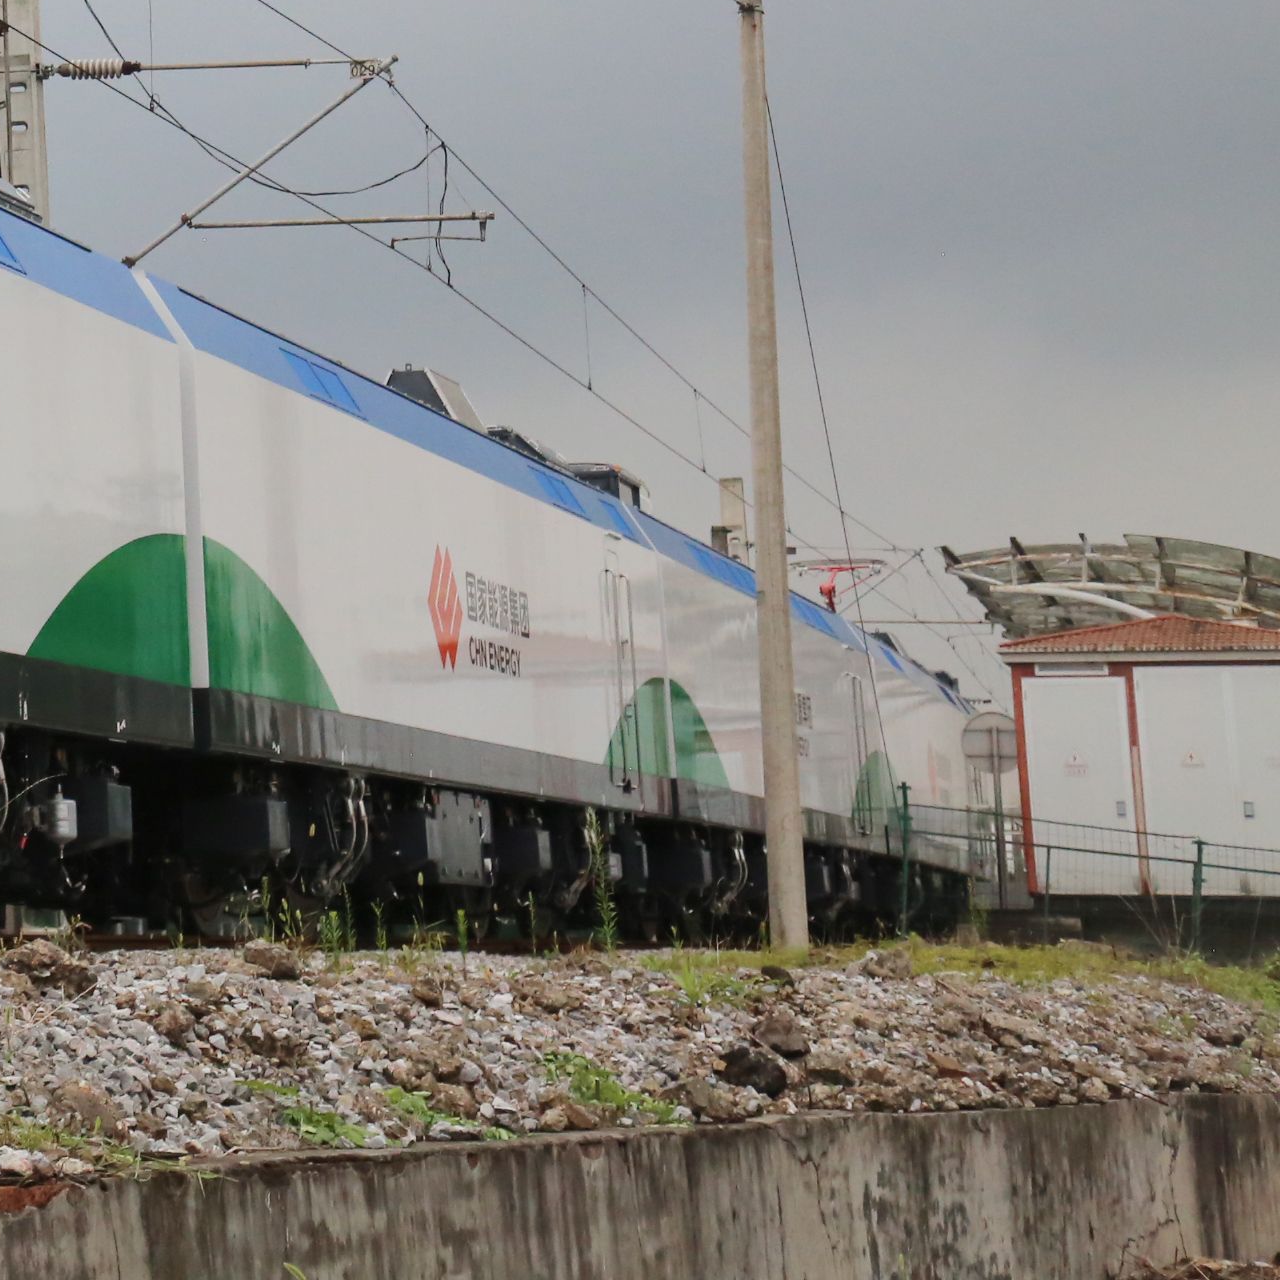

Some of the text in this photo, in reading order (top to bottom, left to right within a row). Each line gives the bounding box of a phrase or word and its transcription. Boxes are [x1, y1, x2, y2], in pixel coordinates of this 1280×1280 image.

[465, 571, 529, 638] 国家能源集团
[469, 636, 521, 677] CHN ENERGY
